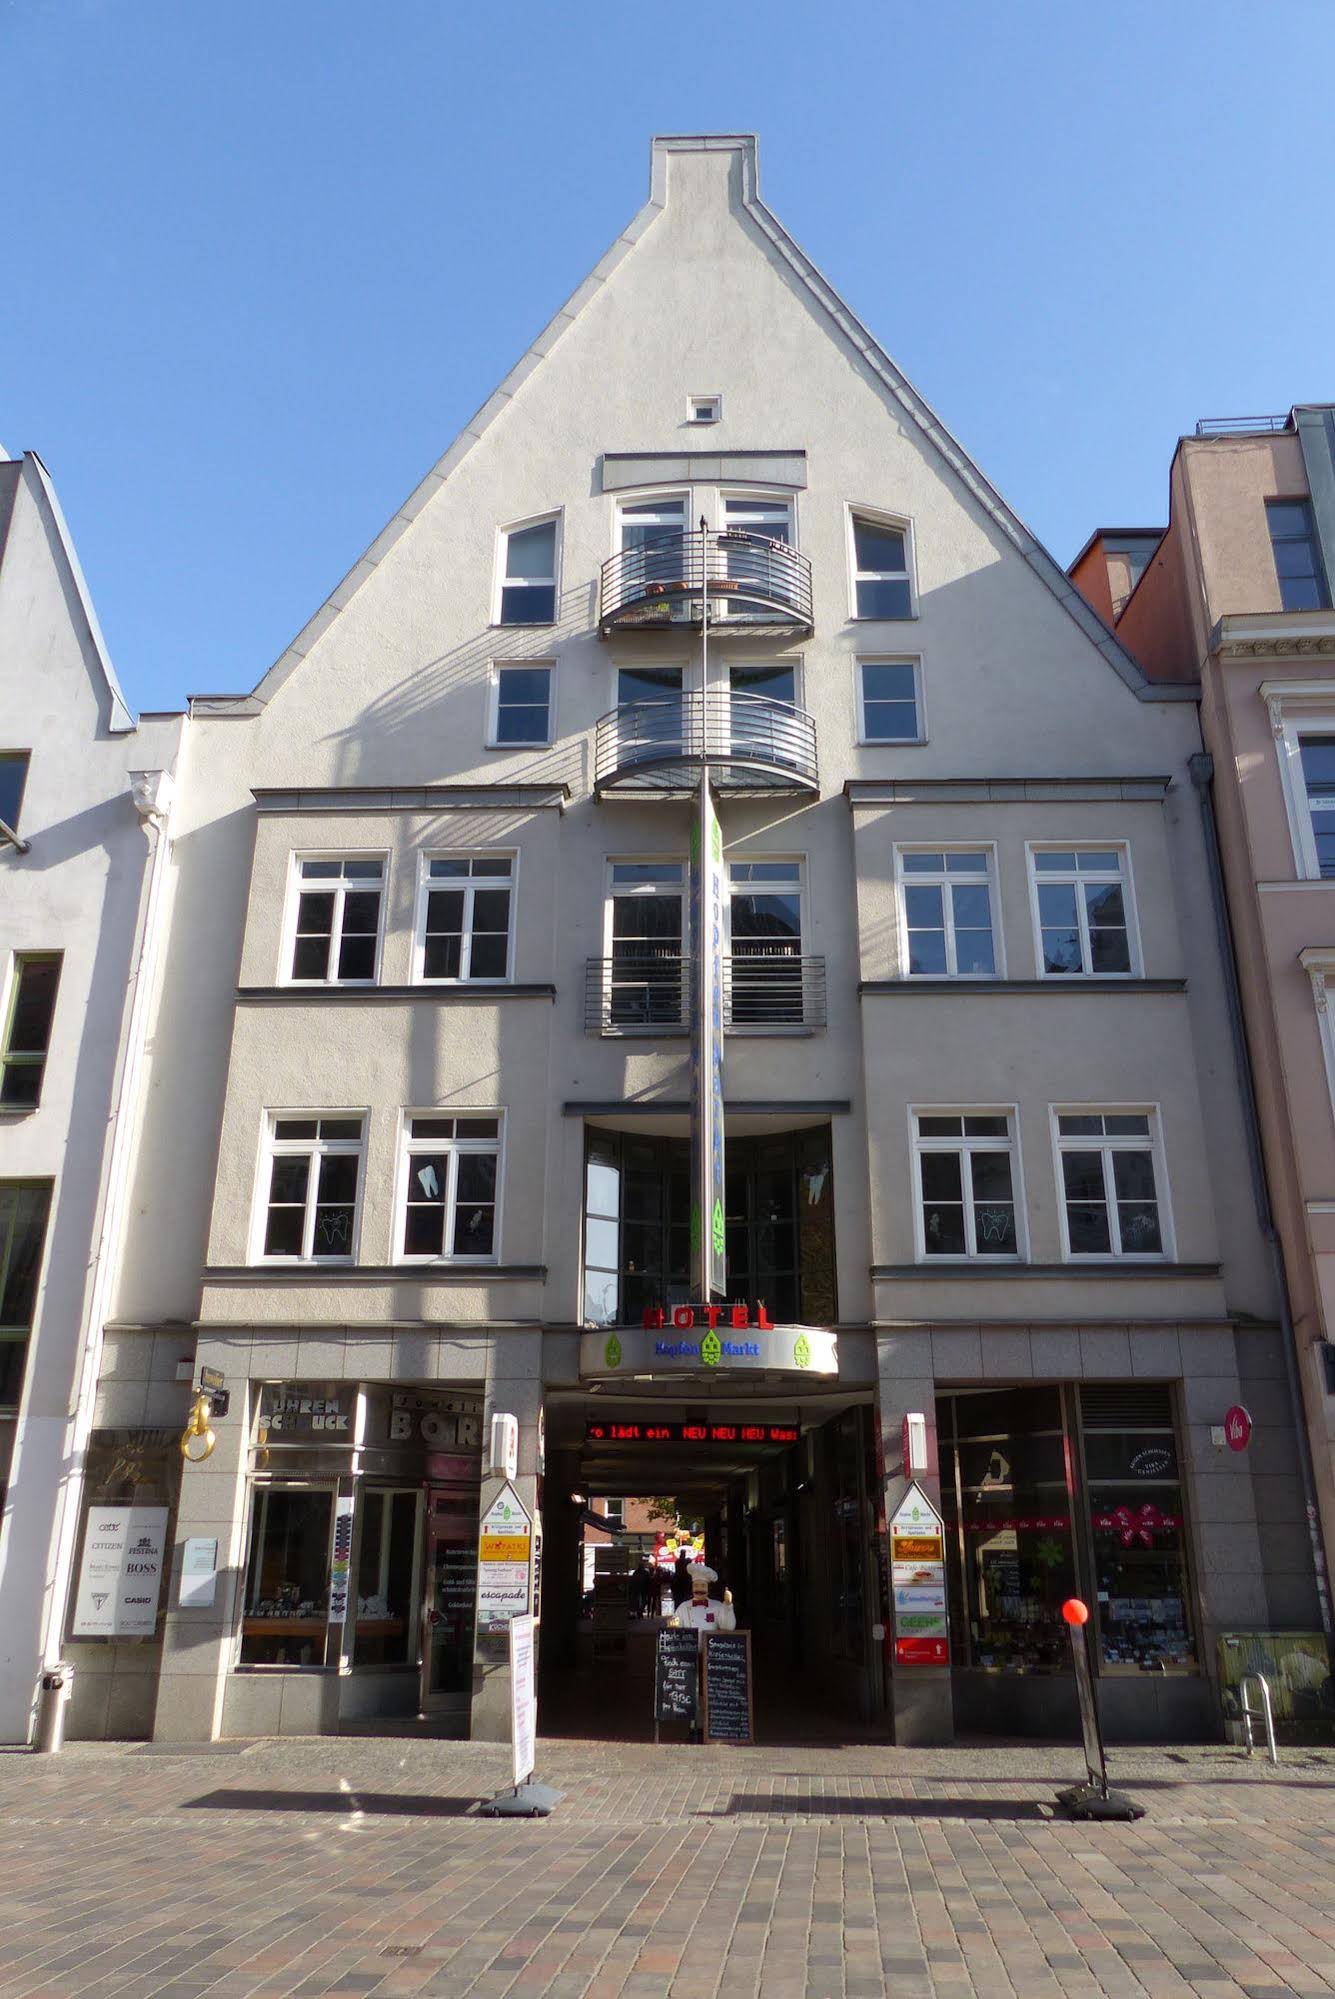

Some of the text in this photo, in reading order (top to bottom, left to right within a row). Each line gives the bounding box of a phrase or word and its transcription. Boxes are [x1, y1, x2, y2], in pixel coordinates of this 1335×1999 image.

[643, 1304, 775, 1331] HOTEL
[722, 1342, 761, 1357] Markt
[272, 1399, 340, 1414] UHREN
[259, 1414, 349, 1431] SCHUCK
[611, 1425, 640, 1439] lädt
[646, 1426, 670, 1439] ein
[682, 1427, 707, 1440] NEU
[712, 1427, 736, 1440] NEU
[741, 1427, 765, 1441] NEU
[91, 1542, 124, 1550] CITIZEN
[128, 1547, 159, 1555] FESTINA
[126, 1563, 158, 1573] BOSS
[481, 1588, 526, 1603] escapade
